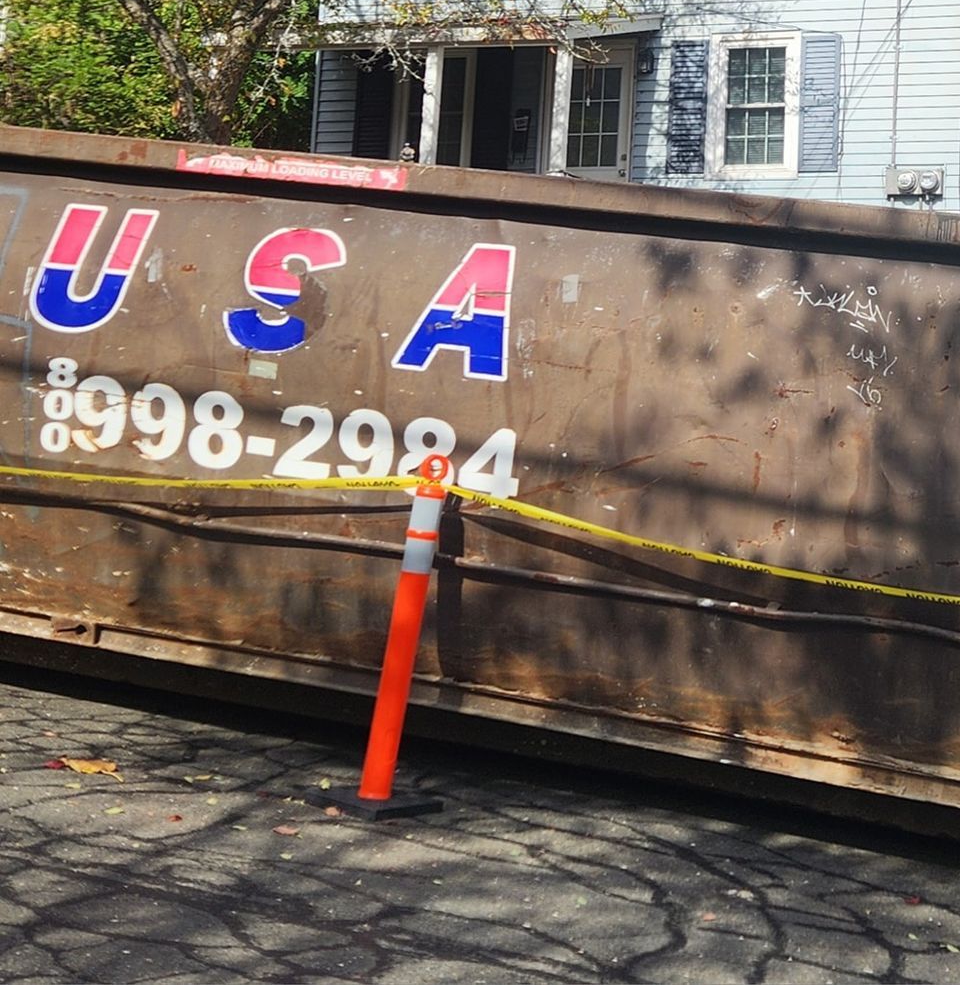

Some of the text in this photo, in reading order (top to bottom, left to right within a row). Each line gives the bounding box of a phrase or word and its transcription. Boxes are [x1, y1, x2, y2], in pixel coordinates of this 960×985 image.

[272, 161, 329, 178] LOADING
[331, 168, 373, 183] LEVEL
[29, 203, 517, 382] U S A
